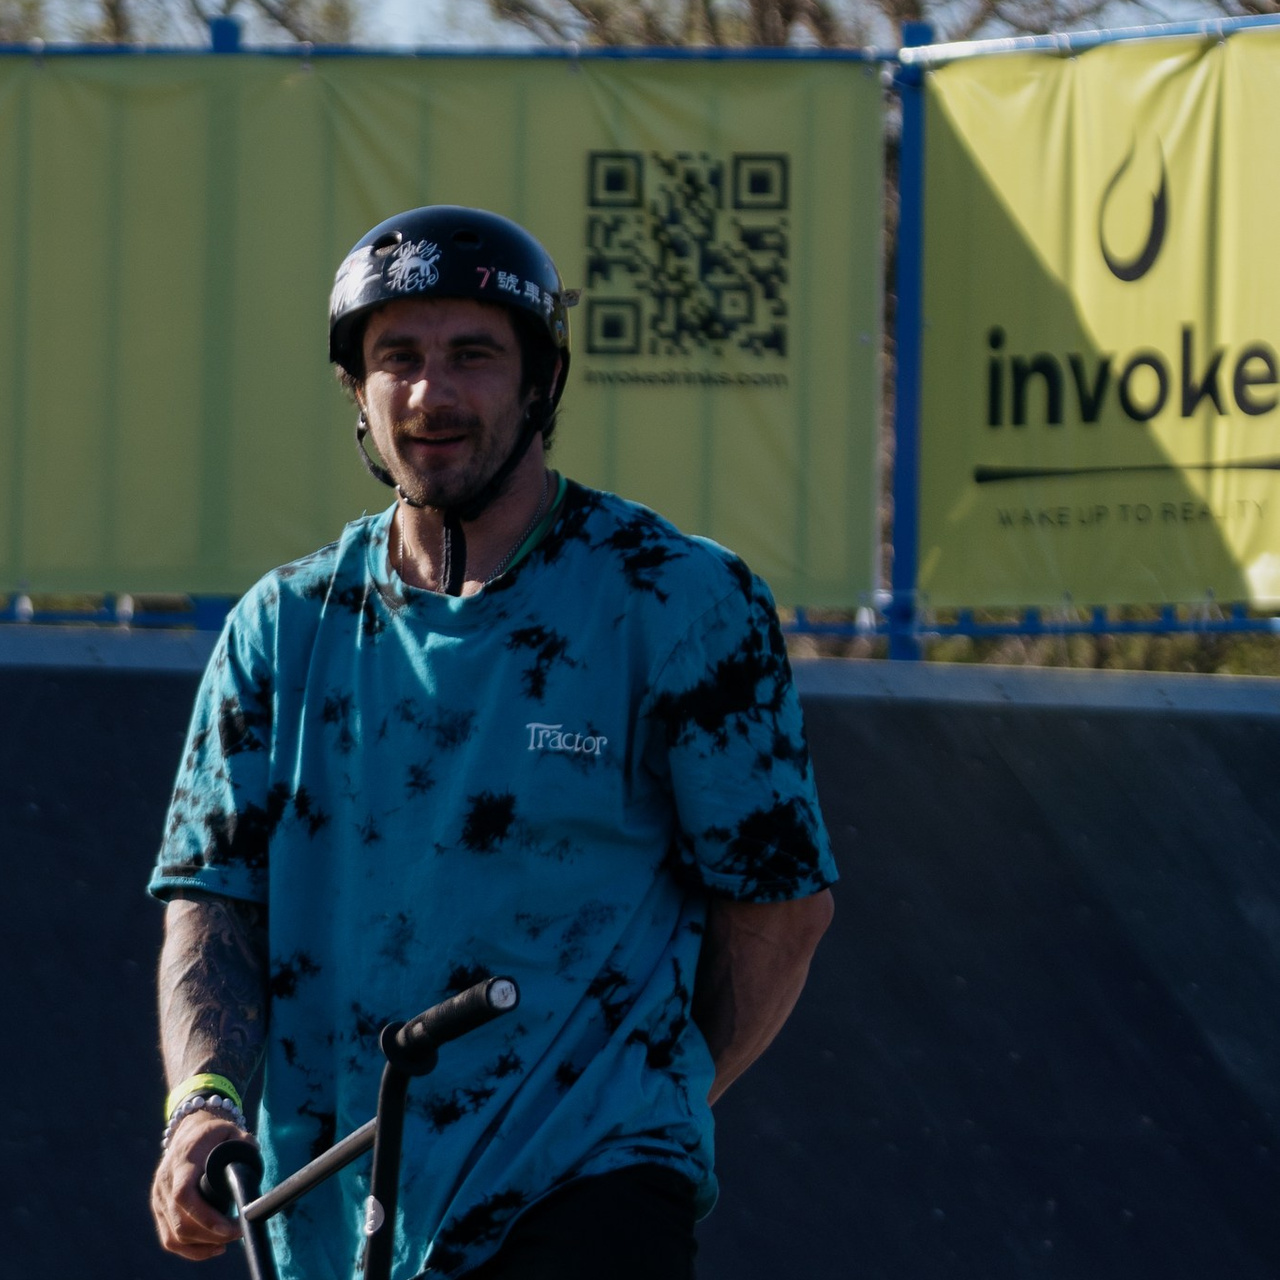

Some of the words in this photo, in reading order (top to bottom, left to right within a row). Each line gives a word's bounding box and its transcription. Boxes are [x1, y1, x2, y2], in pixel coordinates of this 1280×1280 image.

[988, 324, 1280, 426] invoke
[998, 506, 1071, 527] WAKE
[1078, 505, 1110, 524] UP
[1118, 503, 1152, 523] TO
[1161, 499, 1265, 521] REALITY
[526, 722, 608, 755] Tractor
